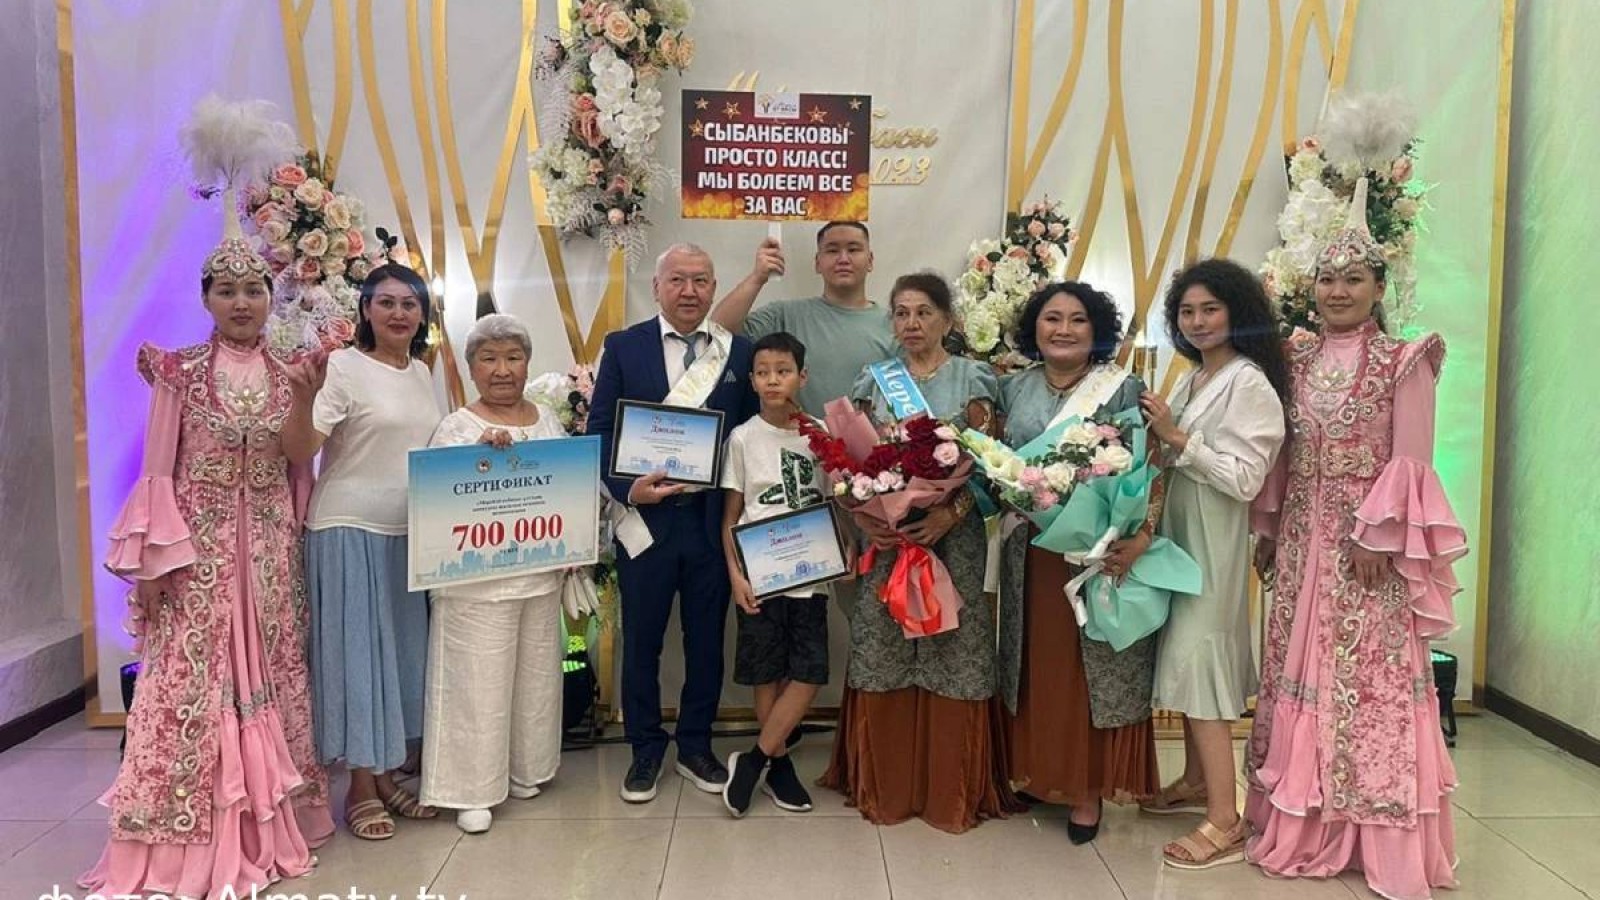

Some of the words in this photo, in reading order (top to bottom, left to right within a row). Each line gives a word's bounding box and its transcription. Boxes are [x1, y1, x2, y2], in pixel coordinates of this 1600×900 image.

[703, 122, 849, 145] СЫБАНБЕКОВЫ
[704, 148, 777, 168] ПРОСТО
[782, 150, 848, 169] КЛАСС!
[697, 172, 733, 189] МЫ
[736, 173, 814, 191] БОЛЕЕМ
[818, 174, 853, 192] ВСЕ
[744, 196, 767, 214] ЗА
[771, 197, 807, 216] ВАС
[453, 474, 553, 496] СЕРТИФИКАТ
[452, 519, 505, 551] 700
[513, 513, 563, 544] 000
